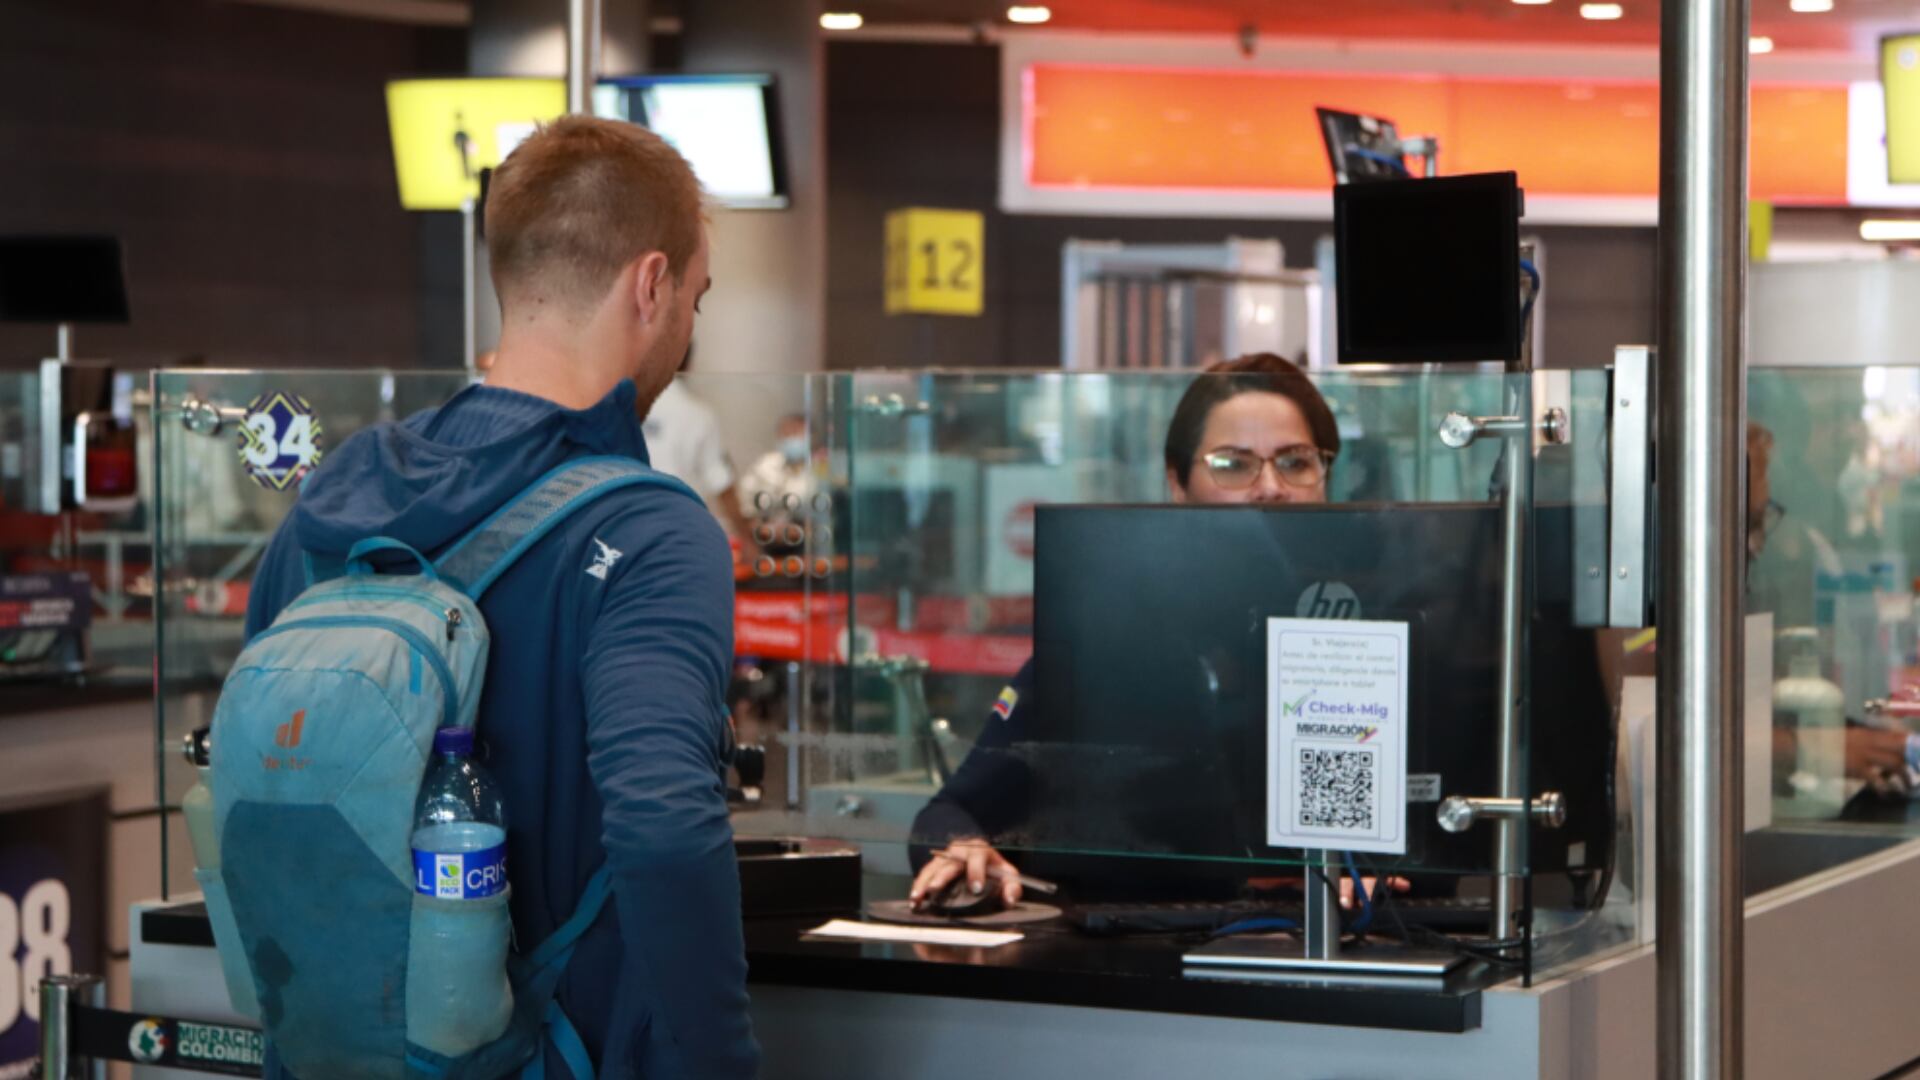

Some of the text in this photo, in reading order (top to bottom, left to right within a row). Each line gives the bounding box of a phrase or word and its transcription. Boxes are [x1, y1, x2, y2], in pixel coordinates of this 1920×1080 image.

[921, 239, 976, 290] 12
[245, 411, 316, 467] 34
[1306, 650, 1318, 660] de
[1308, 701, 1389, 719] Check-Mig
[1296, 722, 1371, 737] MIGRACIÓN
[177, 1021, 263, 1048] MIGRACIO
